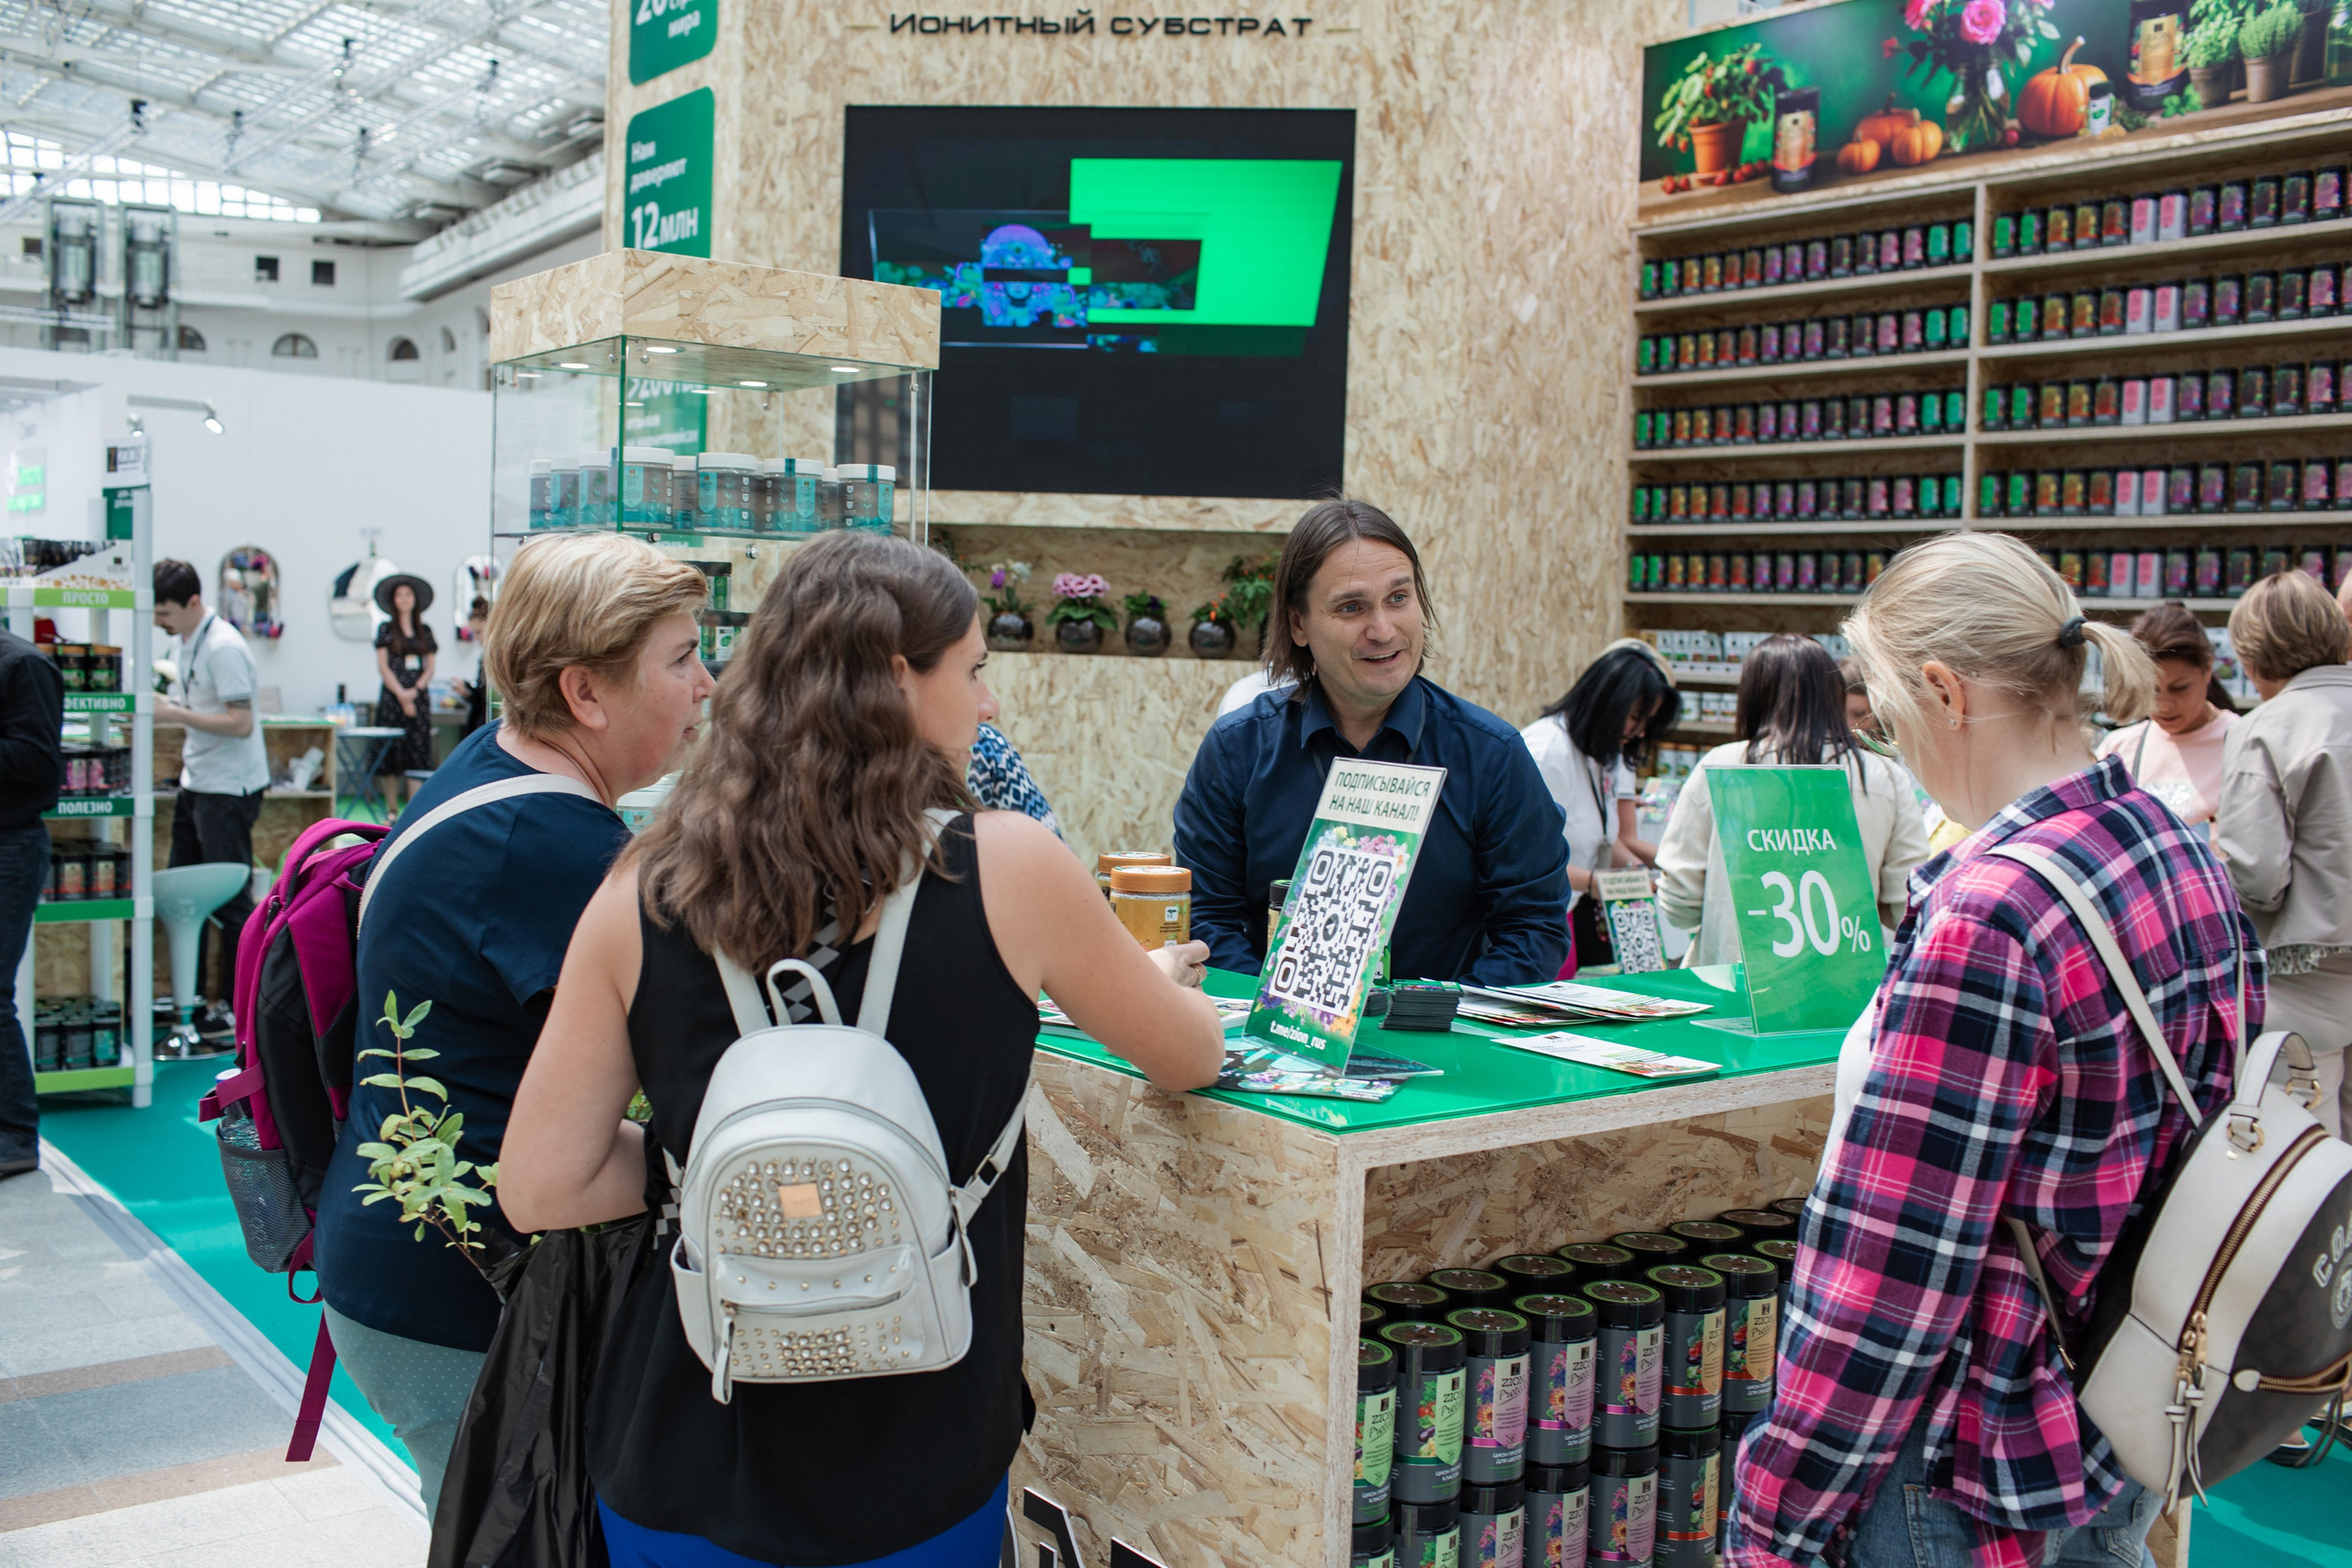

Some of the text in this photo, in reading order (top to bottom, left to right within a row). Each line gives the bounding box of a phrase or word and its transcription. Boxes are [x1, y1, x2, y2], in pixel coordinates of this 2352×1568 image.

[668, 9, 701, 39] мира
[889, 9, 1314, 36] ИОНИТНЫЙ СУБСТРАТ
[631, 141, 656, 164] Нам
[629, 157, 687, 195] доверяют
[62, 591, 109, 605] ПРОСТО
[63, 697, 127, 710] ФЕКТИВНО
[1335, 772, 1430, 797] ПОДПИСЫВАЙСЯ
[57, 800, 114, 815] ПОЛЕЗНО
[1329, 795, 1420, 821] НА НАШ КАНАЛ!
[1747, 829, 1838, 855] СКИДКА
[1747, 870, 1871, 958] -30%
[1270, 1020, 1327, 1050] t.me/zion_rus
[1753, 1314, 1774, 1325] ZION
[1501, 1374, 1526, 1387] ZION
[1443, 1388, 1464, 1404] ZION
[1372, 1409, 1394, 1425] ZION
[1634, 1492, 1655, 1505] ZION
